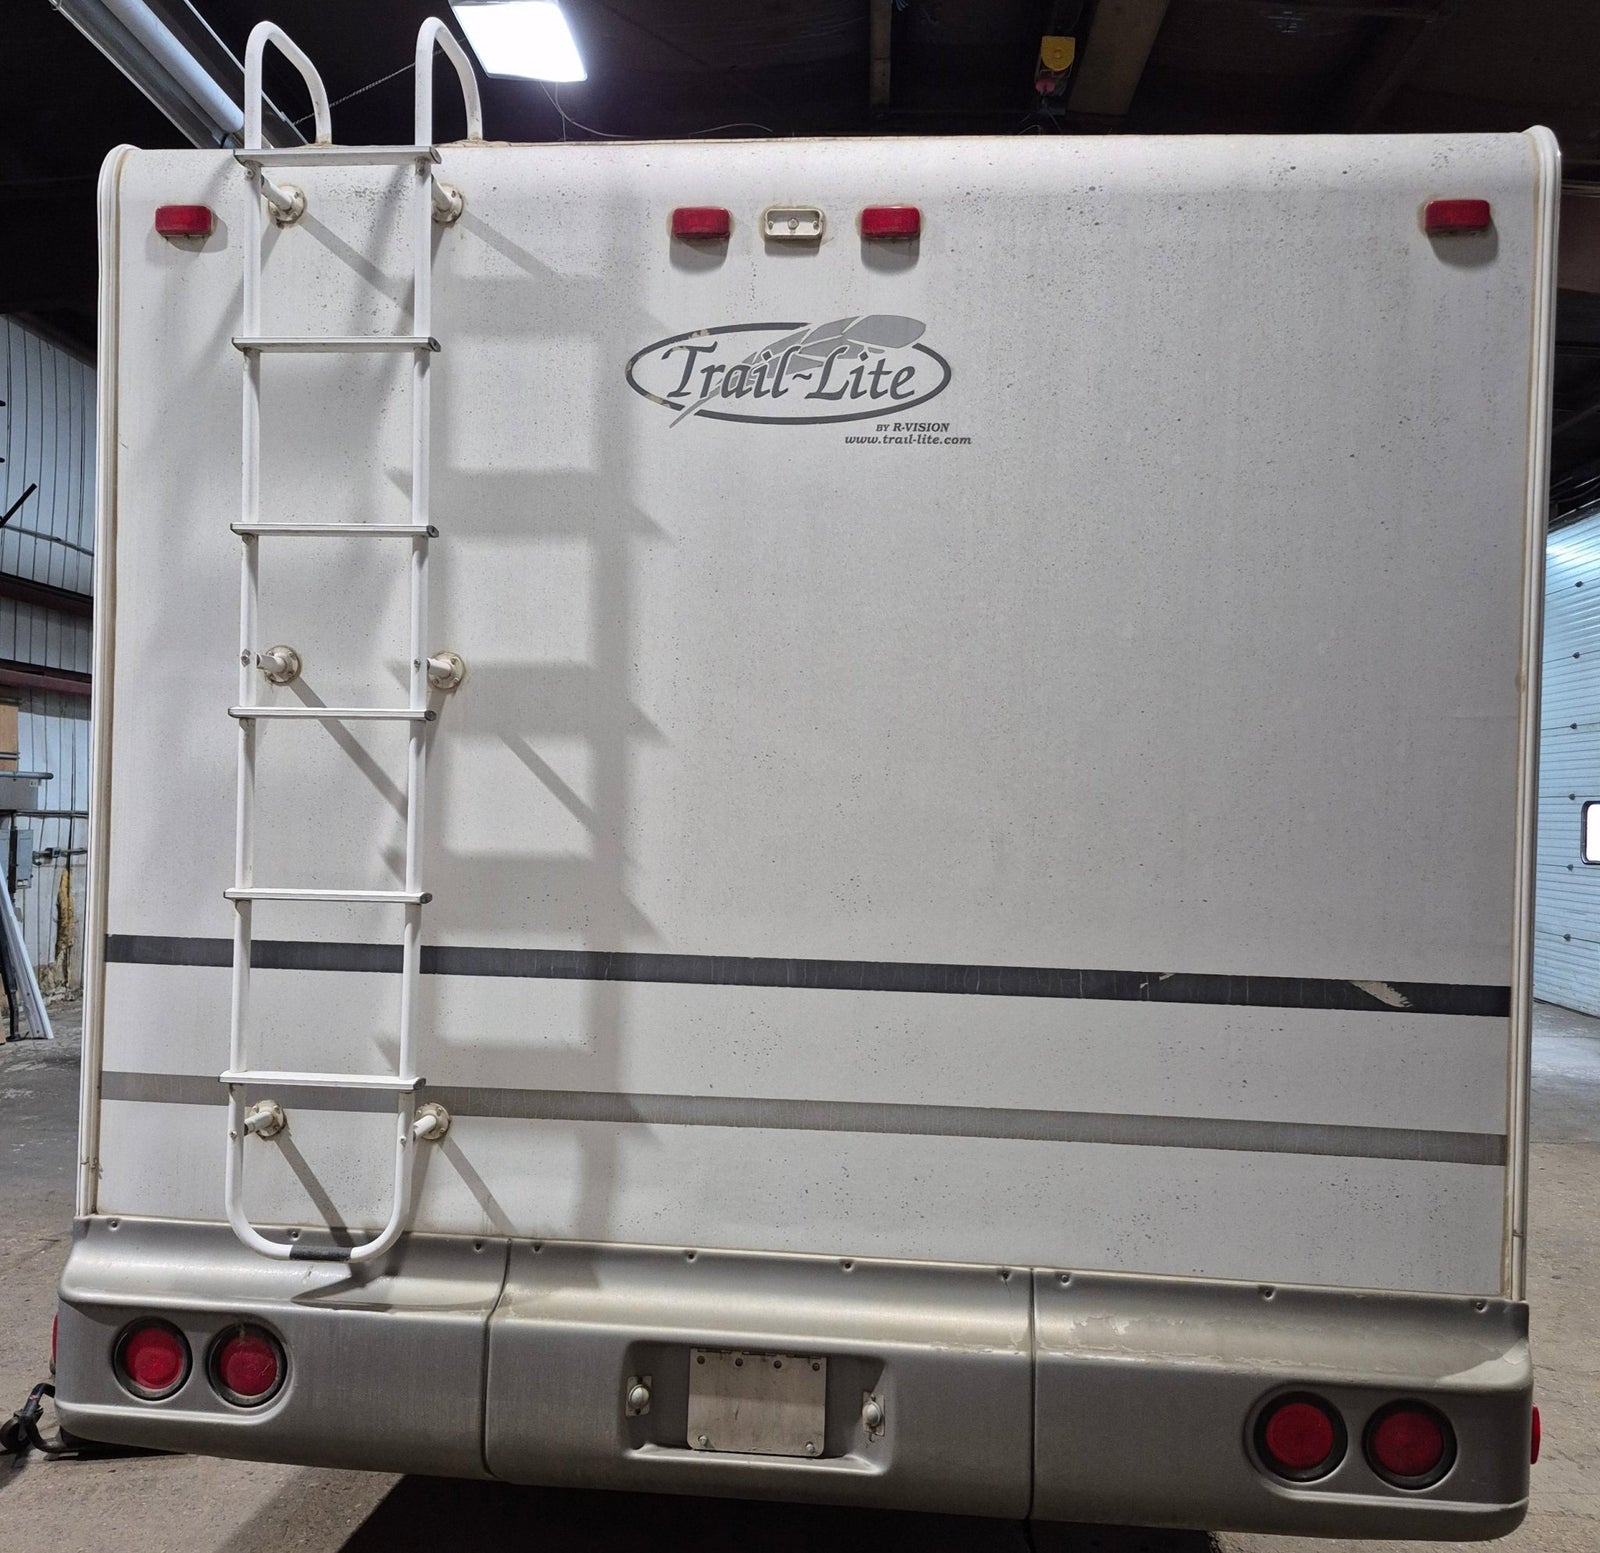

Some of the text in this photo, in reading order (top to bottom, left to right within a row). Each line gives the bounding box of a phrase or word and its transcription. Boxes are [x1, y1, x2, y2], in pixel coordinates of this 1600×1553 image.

[875, 422, 950, 432] BY R-VISION
[844, 433, 972, 445] www.trail-lite.com
